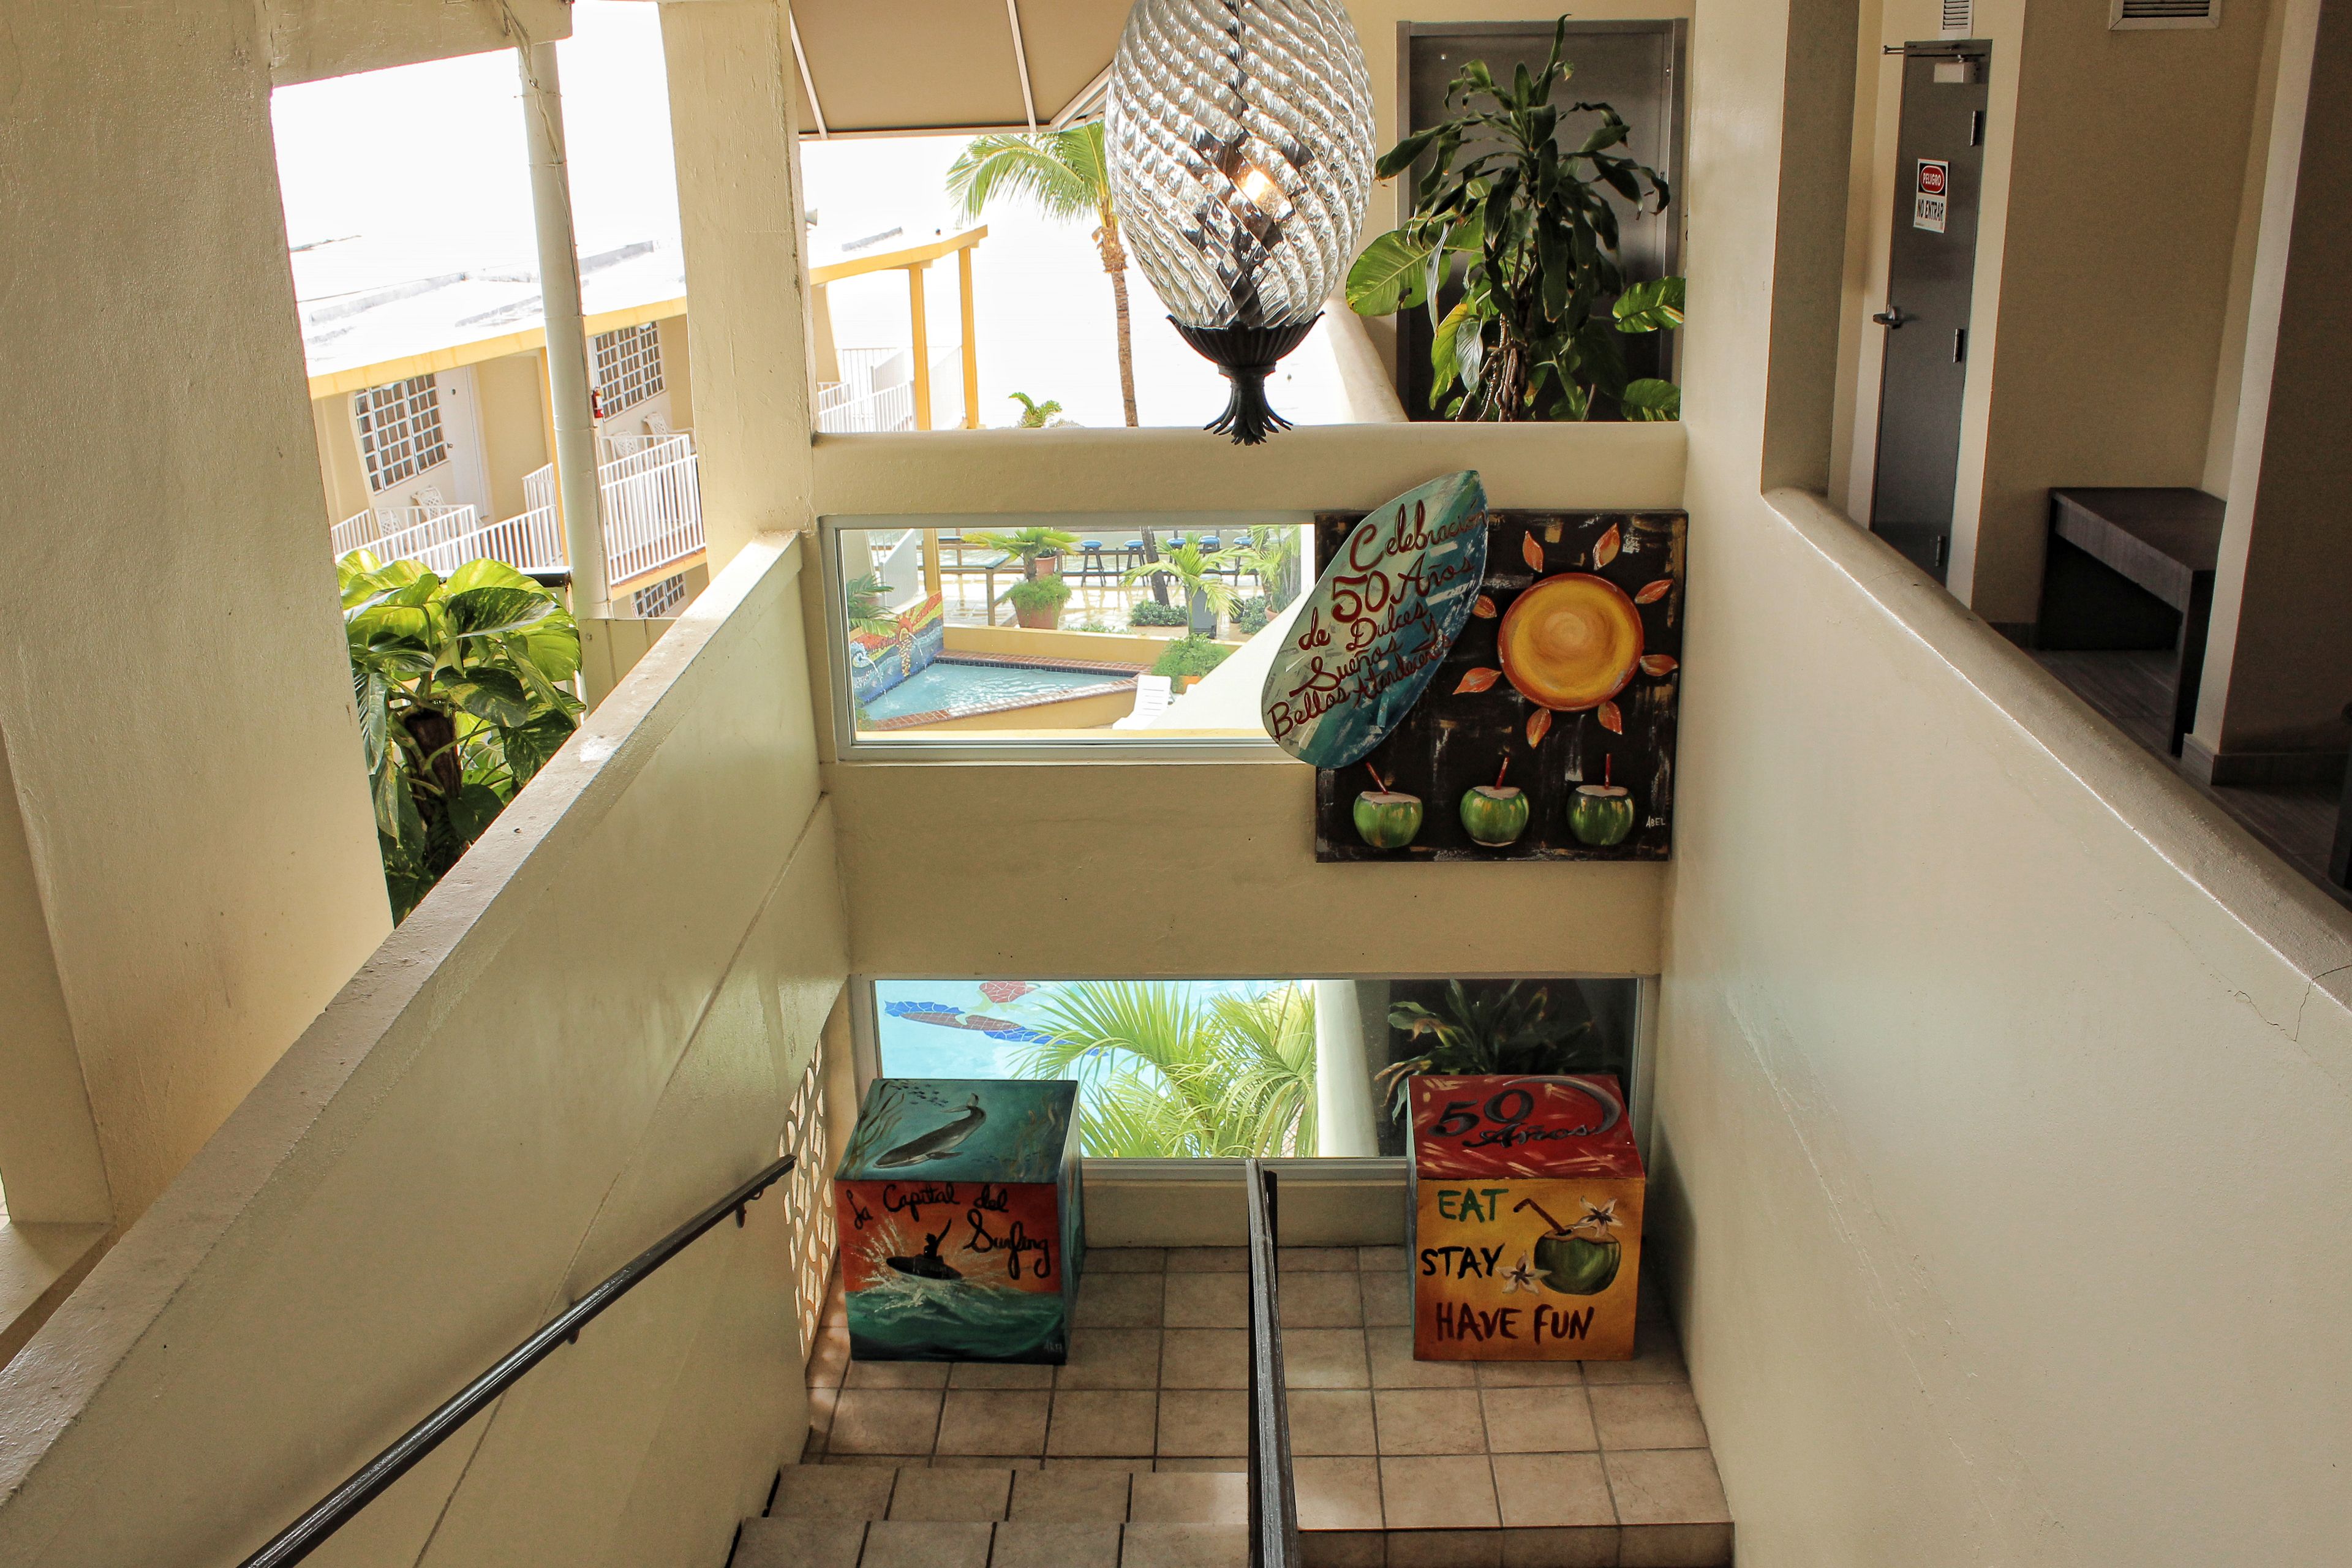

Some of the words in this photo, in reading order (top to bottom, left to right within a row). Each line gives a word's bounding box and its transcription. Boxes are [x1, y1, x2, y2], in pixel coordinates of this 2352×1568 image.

[1923, 172, 1941, 186] PELIGRO
[1917, 199, 1924, 218] NO
[1925, 200, 1943, 222] ENTRAR
[1350, 499, 1487, 571] Celebración
[1331, 570, 1390, 622] 50
[1390, 552, 1474, 605] Años
[1298, 607, 1331, 650] de
[1346, 601, 1430, 651] Dulces
[1289, 636, 1403, 697] Sueños
[1267, 687, 1350, 742] Bellos
[1646, 815, 1665, 829] ABEL
[1428, 1089, 1534, 1137] 50
[973, 1183, 1009, 1213] del
[1437, 1188, 1509, 1223] EAT
[963, 1208, 1051, 1280] Surfing
[1420, 1243, 1506, 1279] STAY
[1435, 1302, 1522, 1341] HAVE
[1534, 1303, 1595, 1345] FUN
